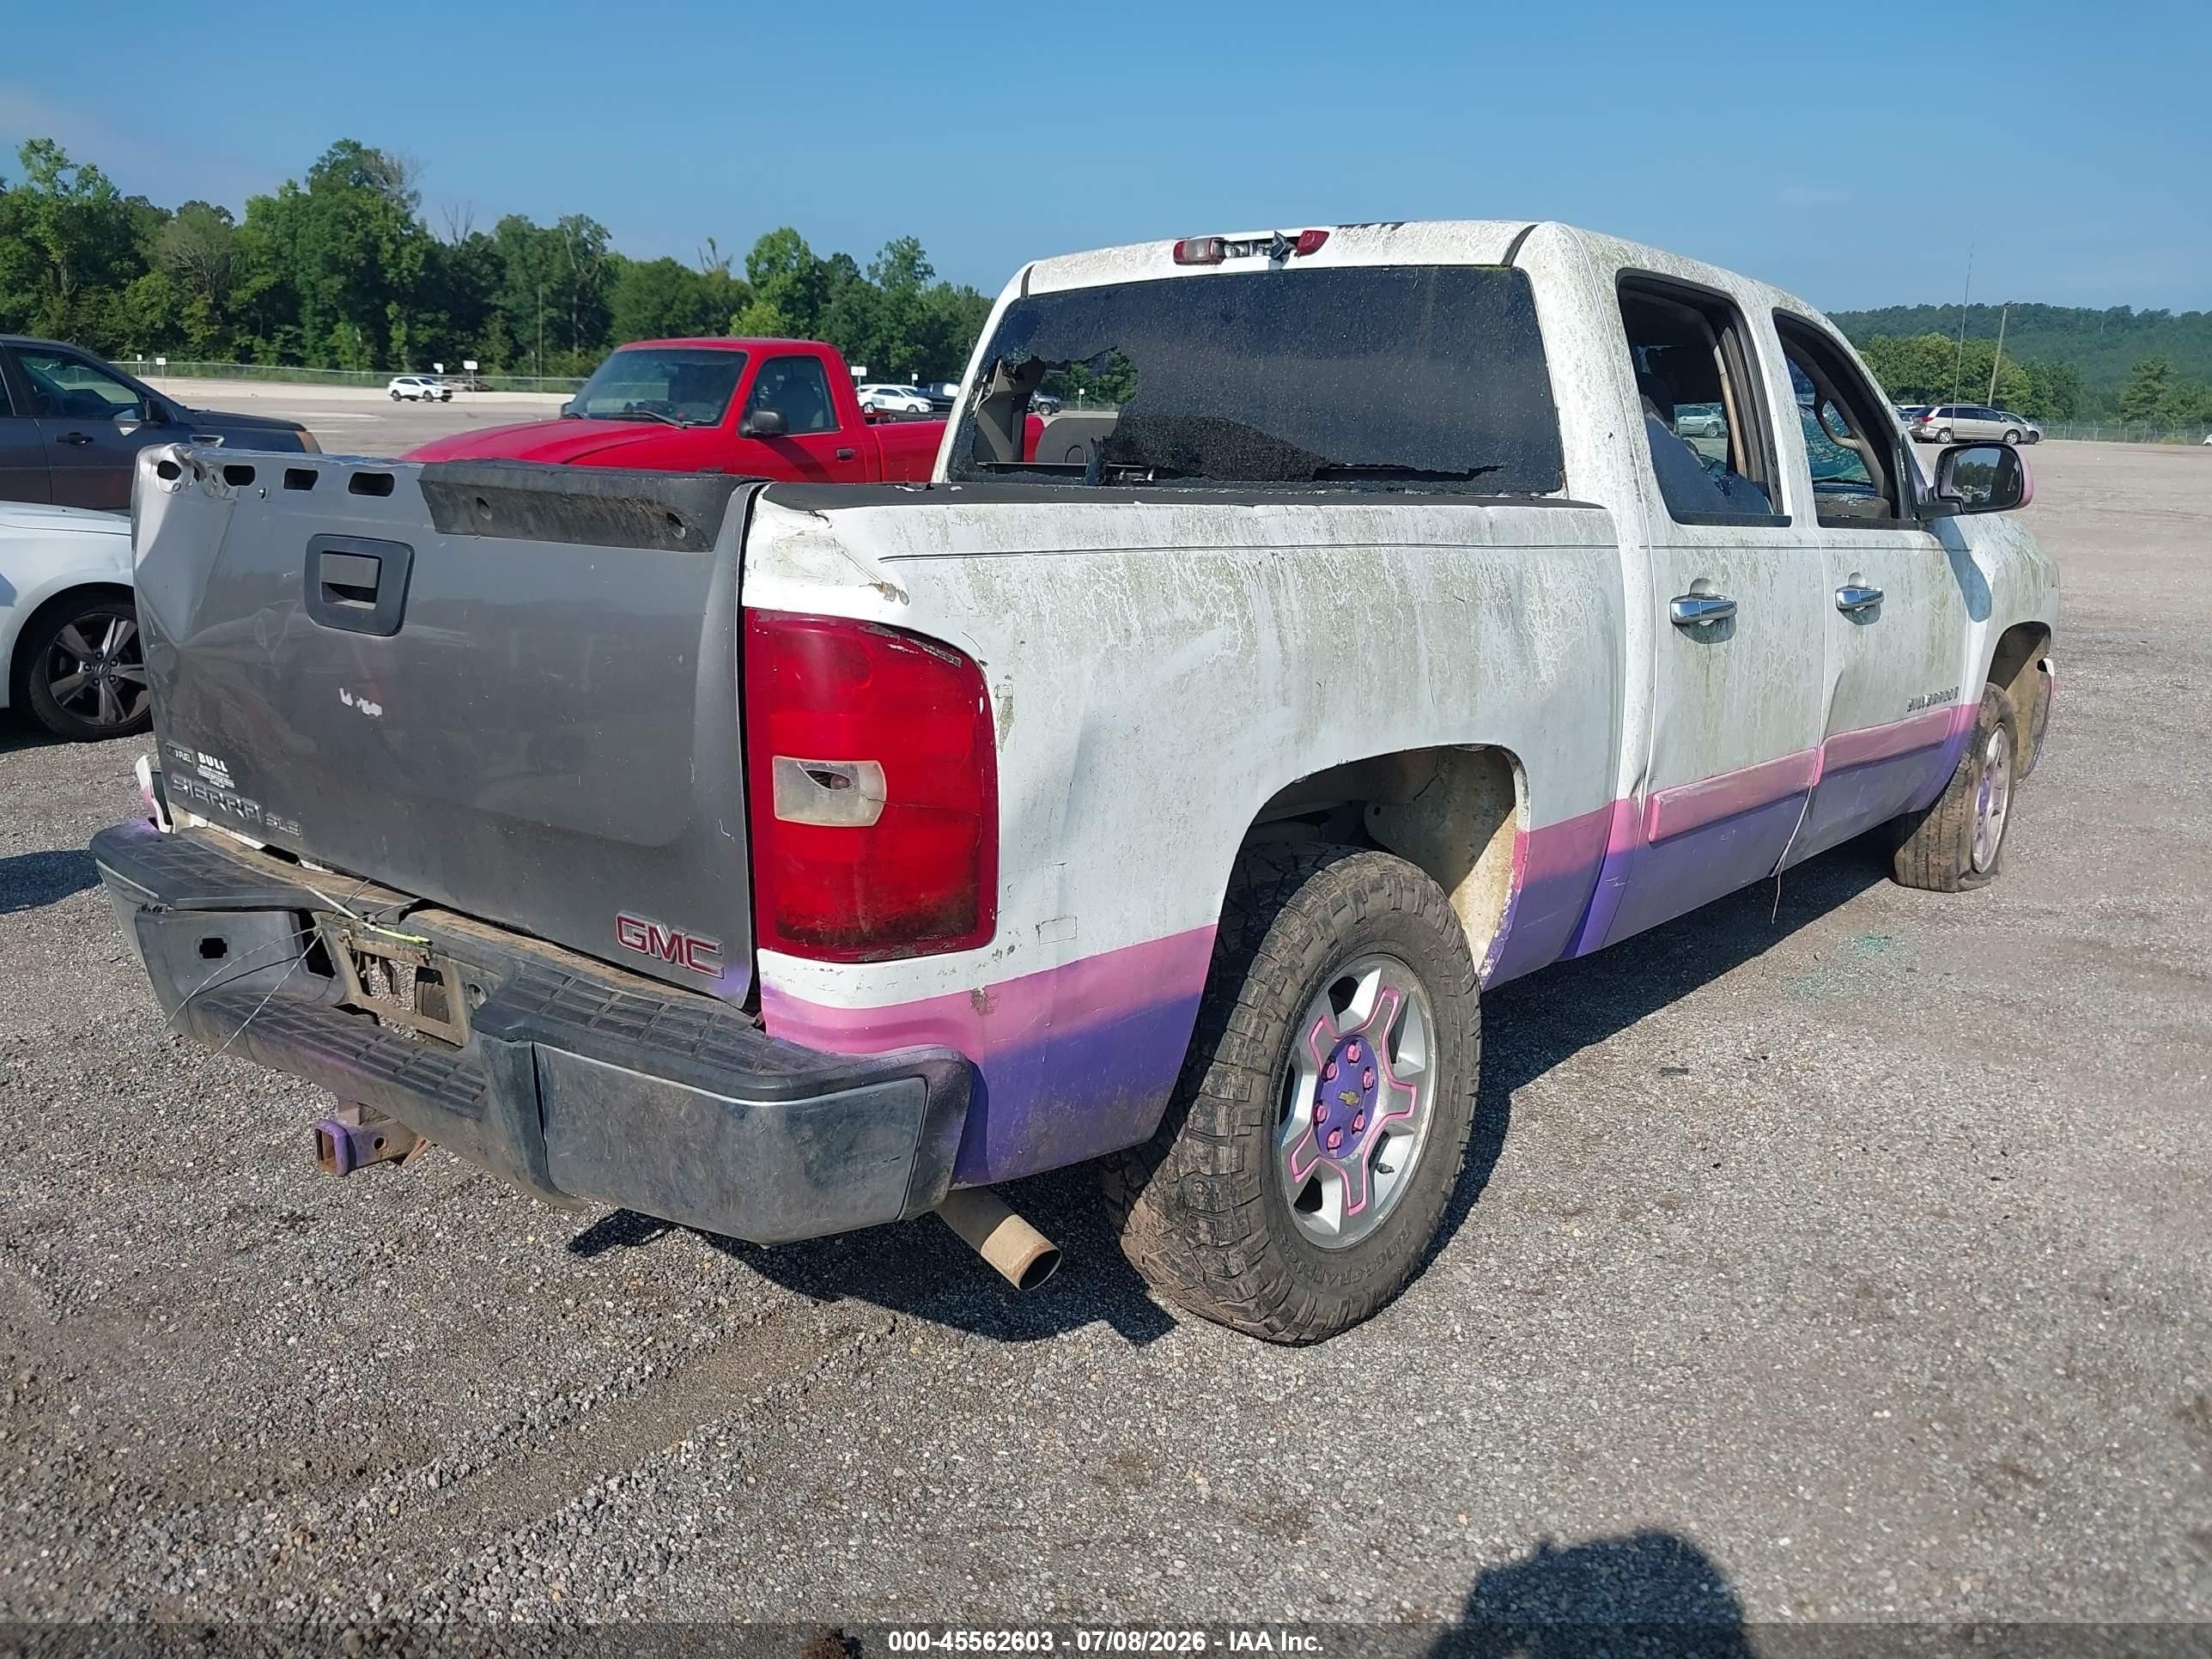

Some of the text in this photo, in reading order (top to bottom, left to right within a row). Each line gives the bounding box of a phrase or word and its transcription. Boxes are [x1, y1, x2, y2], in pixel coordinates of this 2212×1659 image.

[198, 751, 228, 773] BULL
[171, 773, 264, 825] SIERRA
[615, 911, 725, 980] GMC
